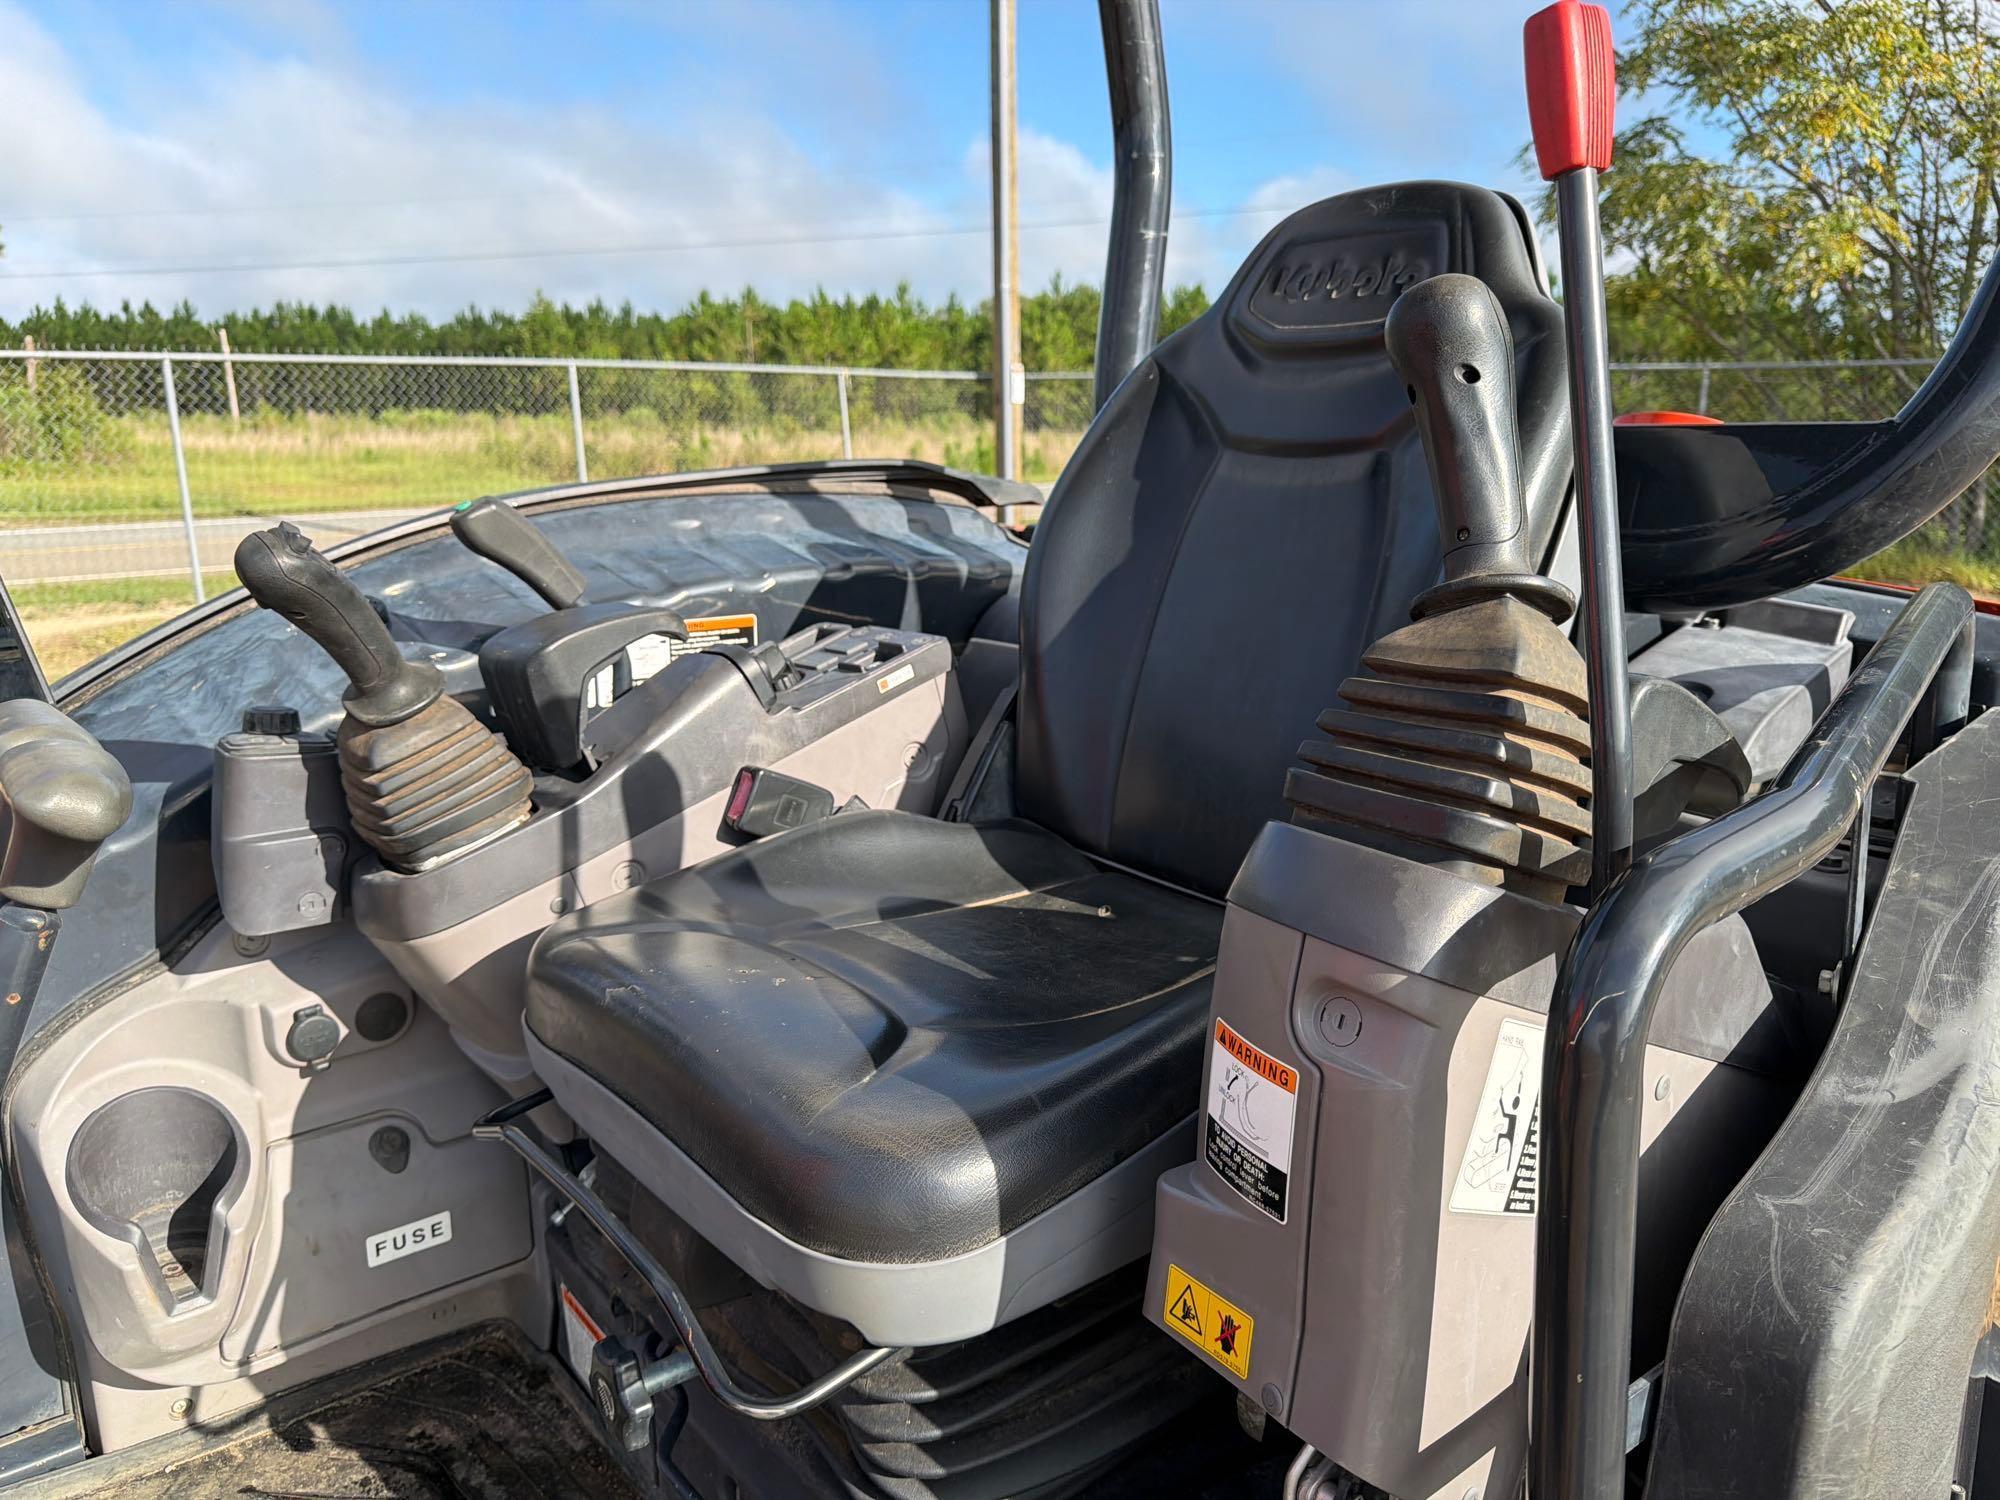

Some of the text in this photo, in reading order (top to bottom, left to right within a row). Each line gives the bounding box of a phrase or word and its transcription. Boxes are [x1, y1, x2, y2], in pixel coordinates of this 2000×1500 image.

[1228, 1033, 1289, 1087] WARNING
[1237, 1144, 1269, 1173] PERSONAL
[1257, 1181, 1280, 1201] before
[375, 1220, 445, 1257] FUSE
